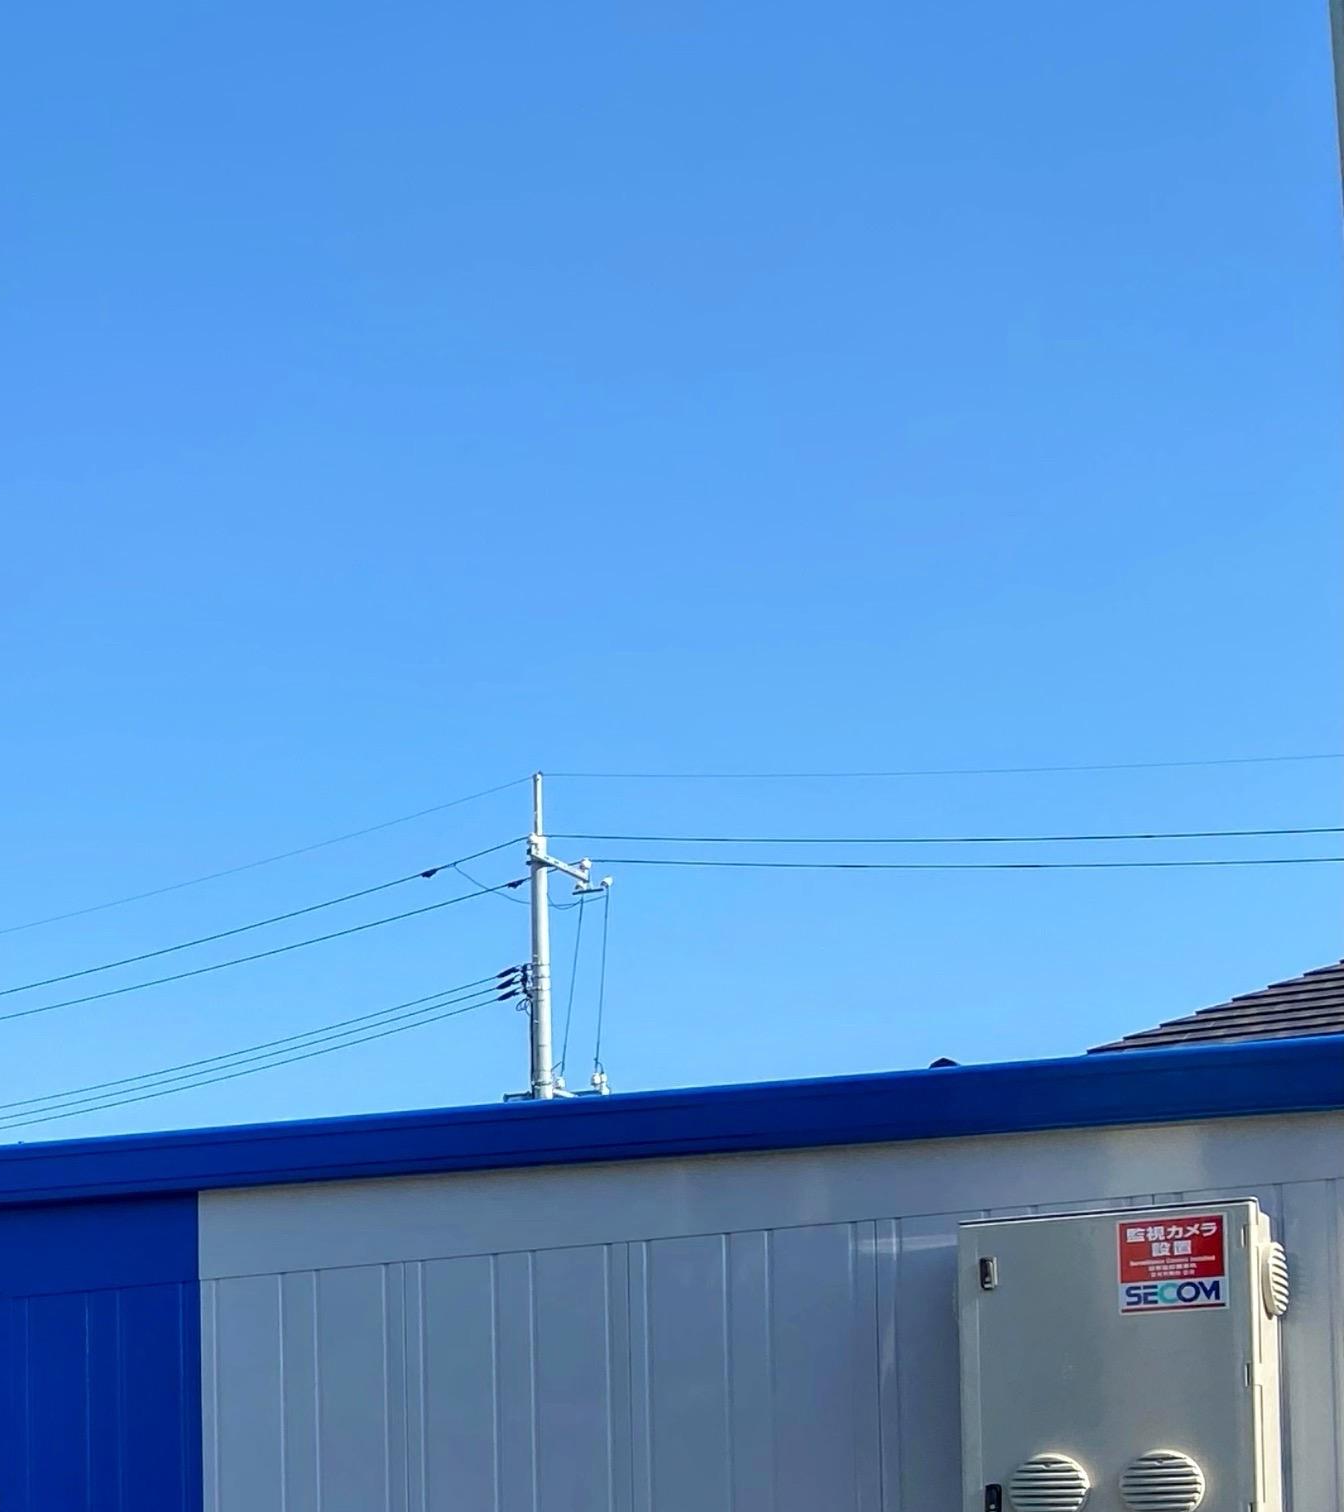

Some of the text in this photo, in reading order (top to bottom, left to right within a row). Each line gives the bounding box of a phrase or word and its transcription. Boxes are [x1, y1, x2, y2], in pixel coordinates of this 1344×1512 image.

[1126, 1222, 1217, 1243] 監視カメラ
[1125, 1280, 1220, 1306] SECOM
